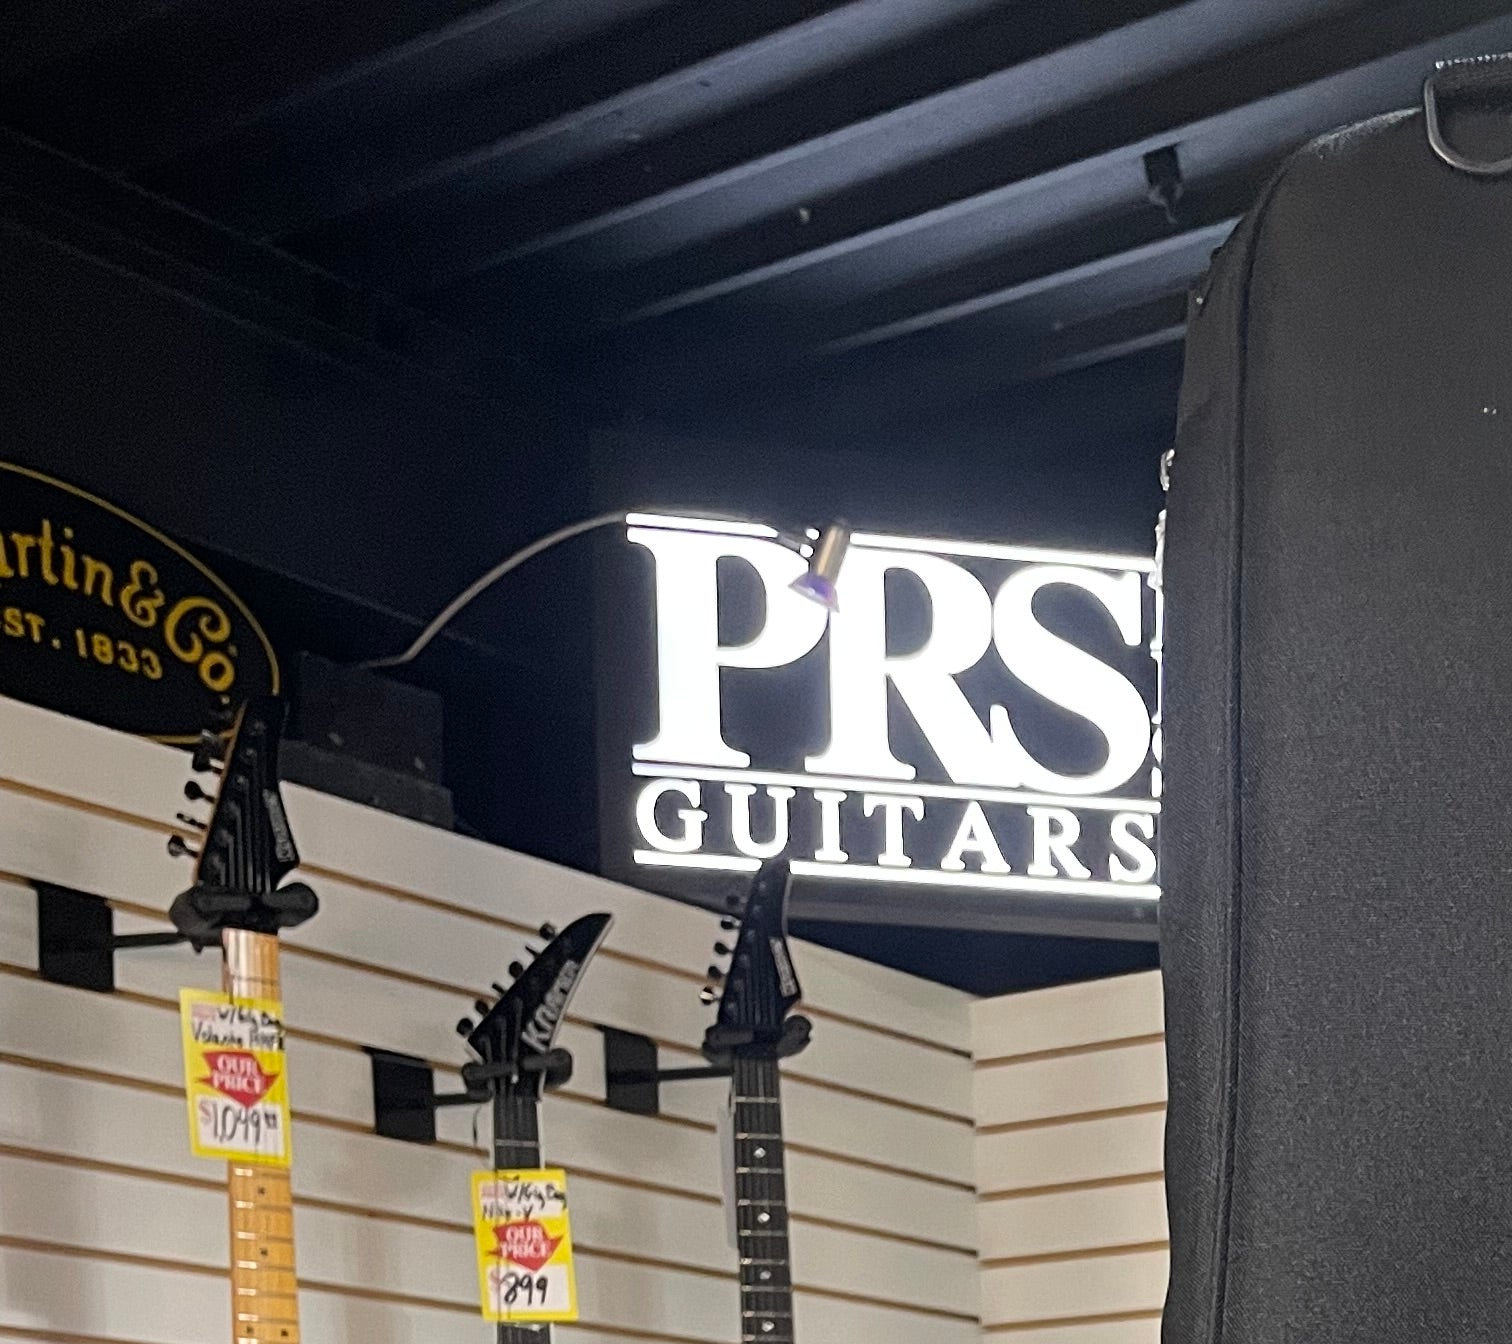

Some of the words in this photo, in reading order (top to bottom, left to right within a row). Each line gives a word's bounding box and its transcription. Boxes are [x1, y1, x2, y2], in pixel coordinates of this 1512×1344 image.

[75, 628, 163, 680] 1833
[627, 527, 1151, 796] PRS
[635, 779, 1157, 882] GUITARS
[217, 1055, 259, 1077] OUR
[212, 1074, 265, 1094] PRICE
[506, 1225, 543, 1243] OUR
[501, 1241, 549, 1260] PRICE
